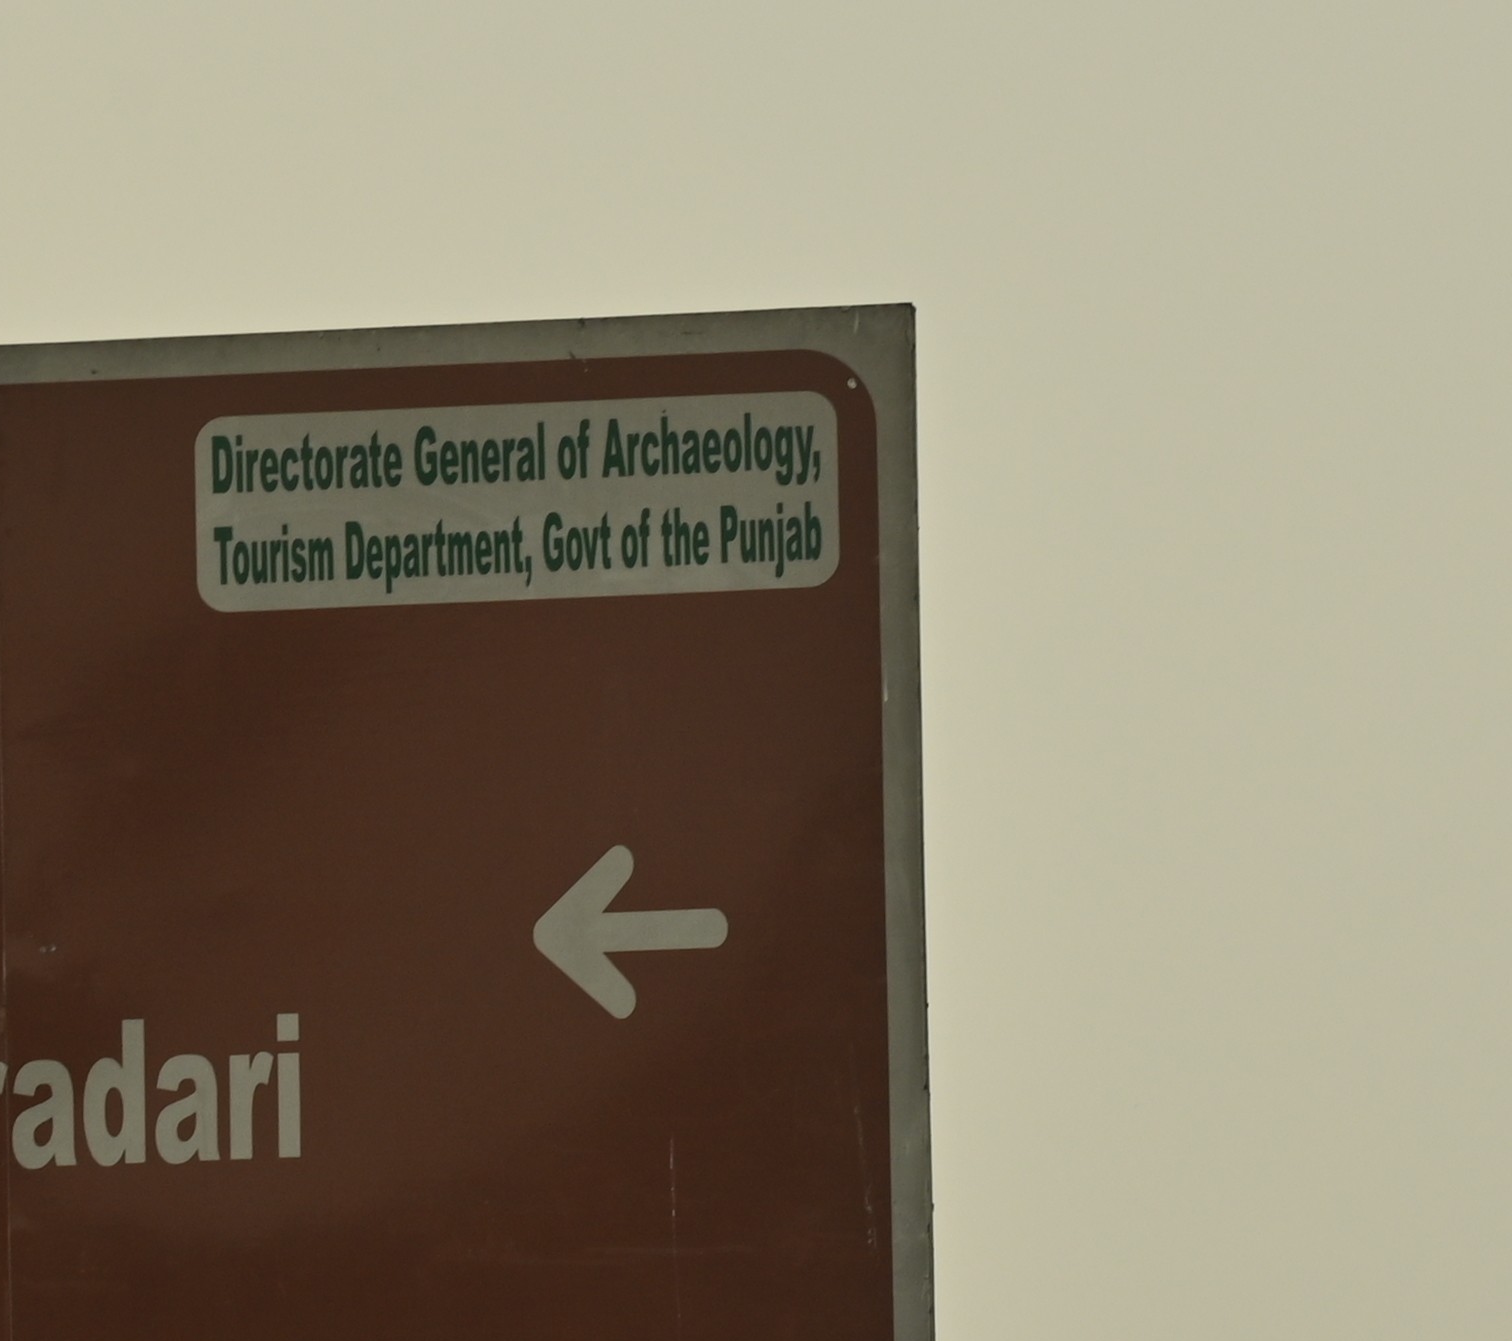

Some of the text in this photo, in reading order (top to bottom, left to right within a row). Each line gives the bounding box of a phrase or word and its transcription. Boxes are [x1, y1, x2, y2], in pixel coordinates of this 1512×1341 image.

[210, 412, 823, 494] Directorate General of Archaeology,
[213, 500, 823, 594] Tourism Department, Govt of the Punjab
